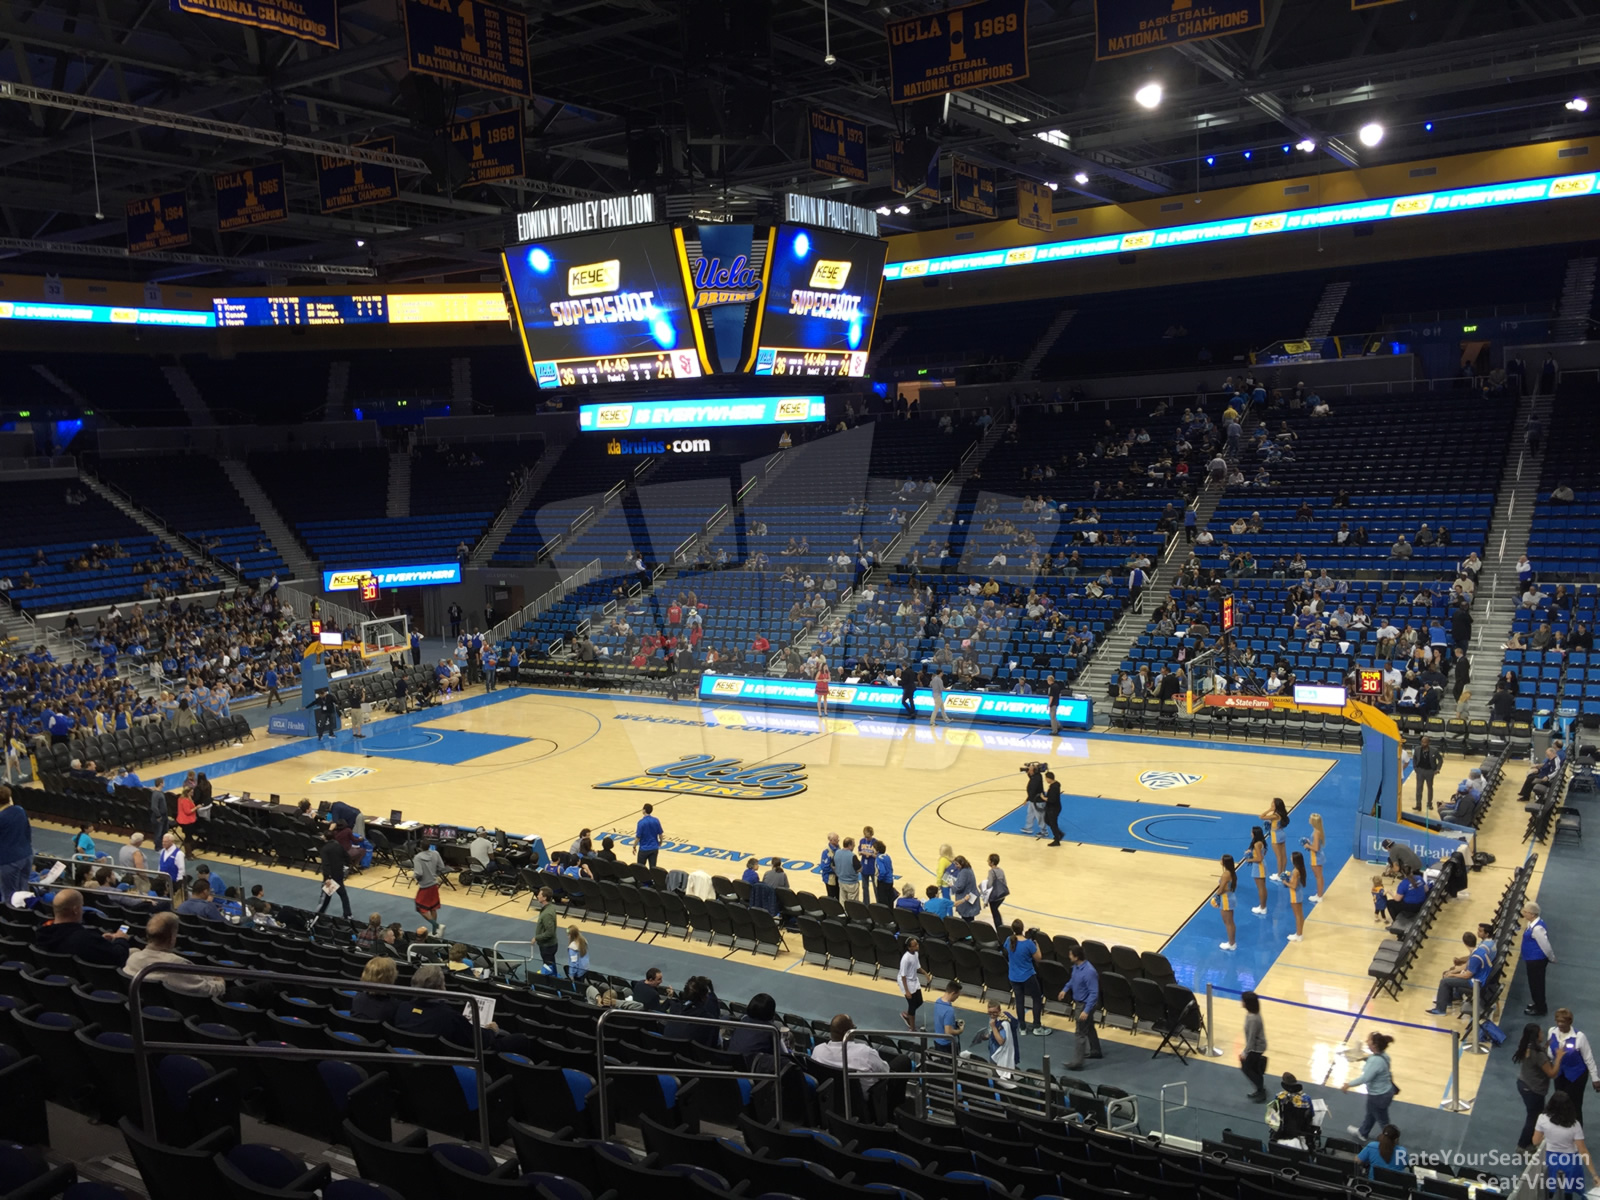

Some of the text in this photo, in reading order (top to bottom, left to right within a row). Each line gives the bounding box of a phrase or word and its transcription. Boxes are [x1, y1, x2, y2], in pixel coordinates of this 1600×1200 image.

[258, 8, 327, 37] CHAMPIONS
[890, 17, 943, 46] UCLA
[973, 12, 1018, 40] 1969
[1139, 6, 1216, 31] BASKETBALL
[1108, 9, 1249, 52] NATIONAL CHAMPIONS
[417, 53, 523, 90] NATIONAL CHAMPIONS
[460, 50, 508, 73] VOLLEYBALL
[925, 57, 988, 78] BASKETBALL
[903, 62, 1014, 97] NATIONAL CHAMPIONS
[811, 112, 837, 134] UCLA
[477, 163, 515, 180] CHAMPIONS
[216, 171, 243, 191] UCLA
[258, 178, 279, 196] 1965
[1554, 178, 1591, 192] KEYES
[127, 200, 151, 217] UCLA
[517, 193, 653, 242] EDWIN W PAULEY PAVILION
[788, 193, 878, 237] EDWIN W PAULEY PAVILION
[694, 254, 762, 290] Ucla
[550, 291, 654, 327] SUPERSHOT
[697, 290, 757, 307] BRUINS
[788, 289, 861, 322] SUPERSHOT
[596, 358, 629, 374] 14:49
[655, 360, 672, 379] 24
[775, 357, 786, 375] 36
[804, 353, 826, 366] 14:49
[838, 360, 850, 375] 24
[560, 368, 576, 386] 36
[600, 407, 628, 423] KEYES
[635, 409, 650, 424] IS
[651, 404, 766, 424] EVERYWHERE
[385, 569, 455, 583] EVERYWHERE
[363, 586, 376, 599] 30
[1361, 671, 1380, 681] 14:49
[1363, 680, 1377, 691] 30
[716, 681, 740, 692] KEYES
[744, 684, 754, 693] IS
[754, 684, 816, 698] EVERYWHERE
[858, 691, 868, 702] IS
[949, 697, 976, 709] KEYES
[982, 701, 994, 711] IS
[287, 720, 305, 731] Health
[613, 714, 720, 728] WOODEN
[725, 725, 821, 736] COURT
[645, 754, 809, 789] Ucla
[612, 776, 766, 797] BRUINS
